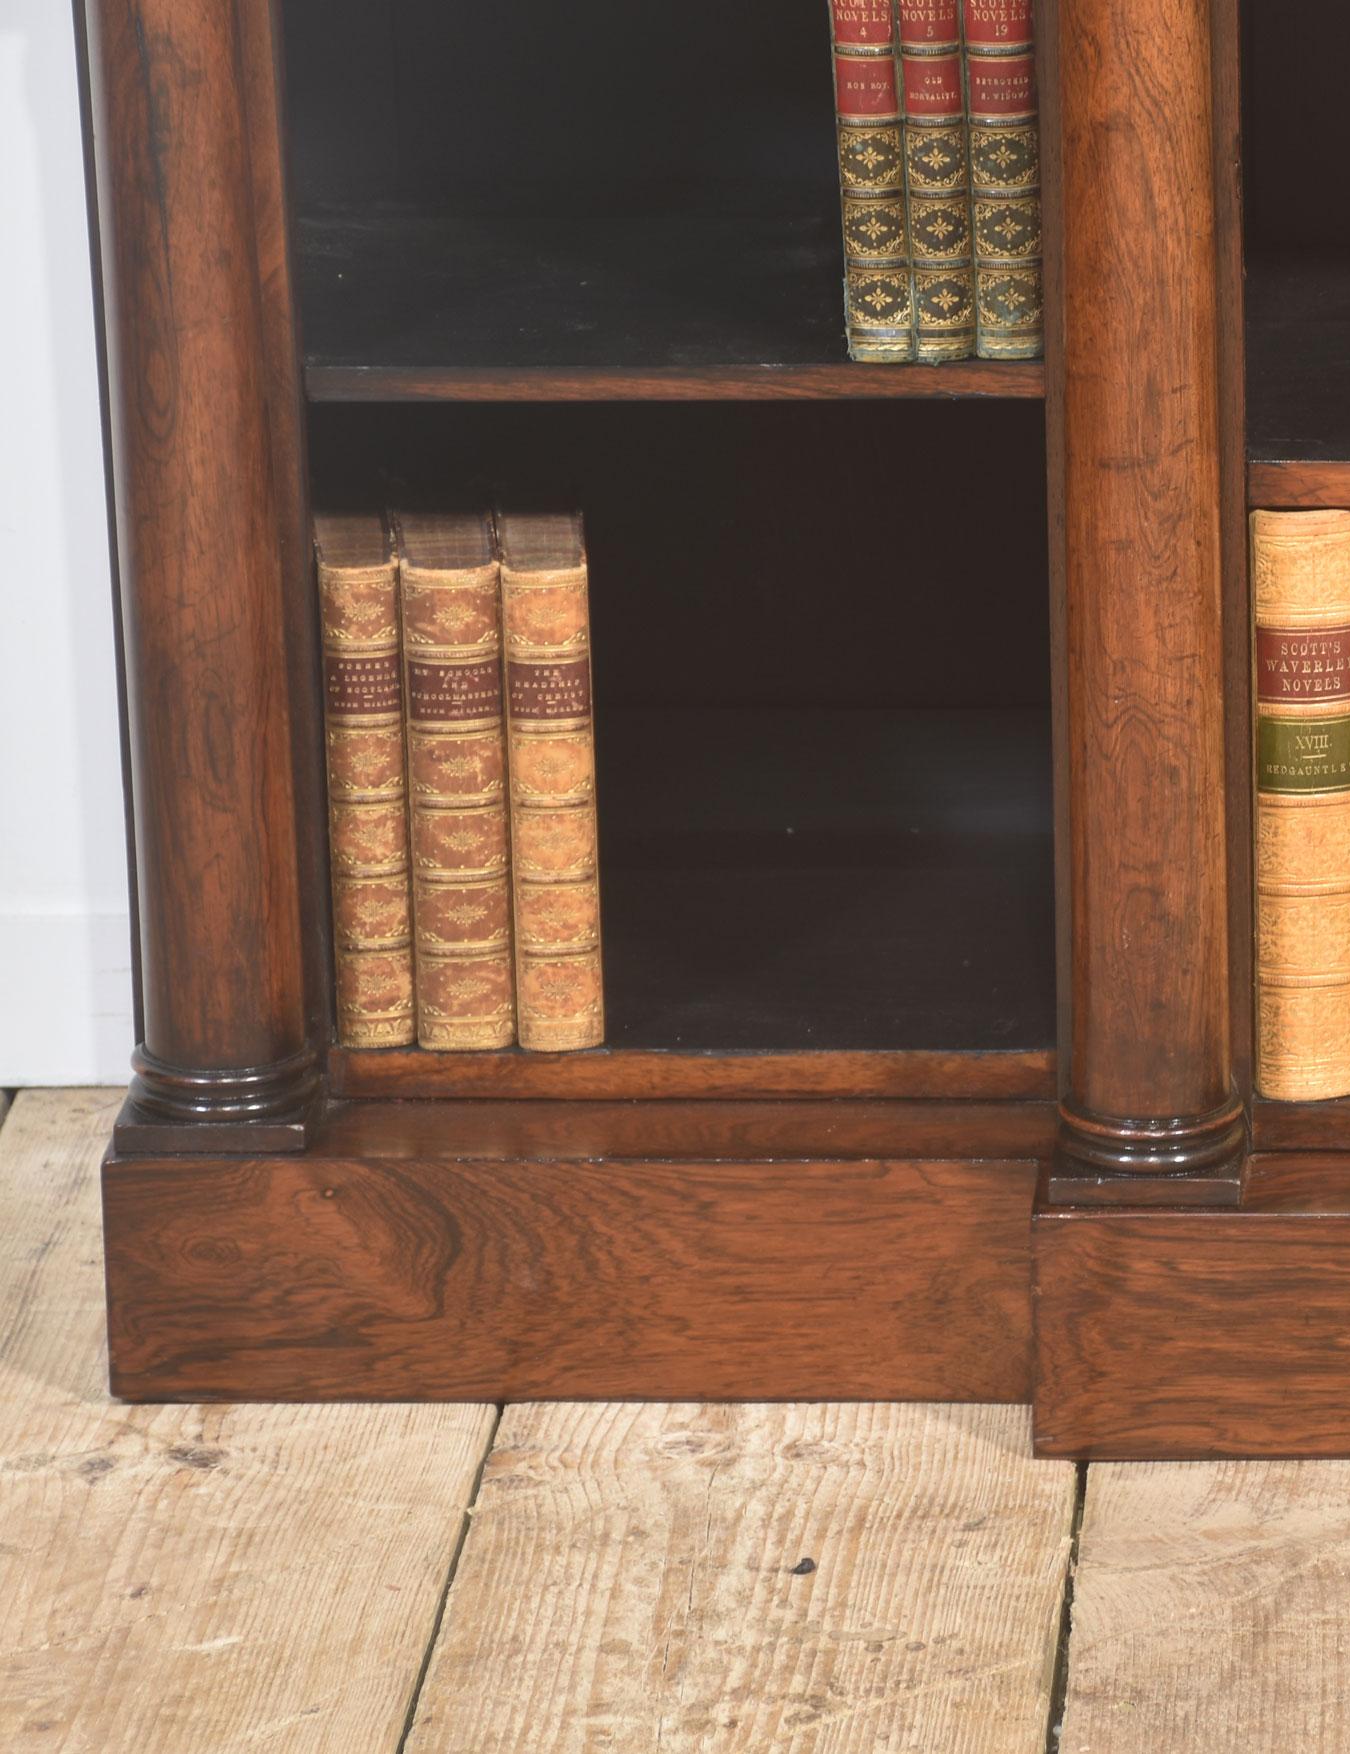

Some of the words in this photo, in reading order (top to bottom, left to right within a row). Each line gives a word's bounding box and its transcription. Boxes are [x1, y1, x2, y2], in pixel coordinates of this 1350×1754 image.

[836, 9, 888, 22] NOVELS
[902, 9, 955, 21] NOVELS
[973, 9, 1027, 21] NOVELS
[859, 26, 867, 38] 4
[926, 25, 934, 38] 5
[995, 24, 1008, 37] 19
[847, 82, 865, 90] ROB
[924, 76, 942, 84] OLD
[1281, 641, 1341, 656] SCOTT'S
[1282, 676, 1341, 692] NOVELS
[1295, 734, 1334, 750] XVIII.
